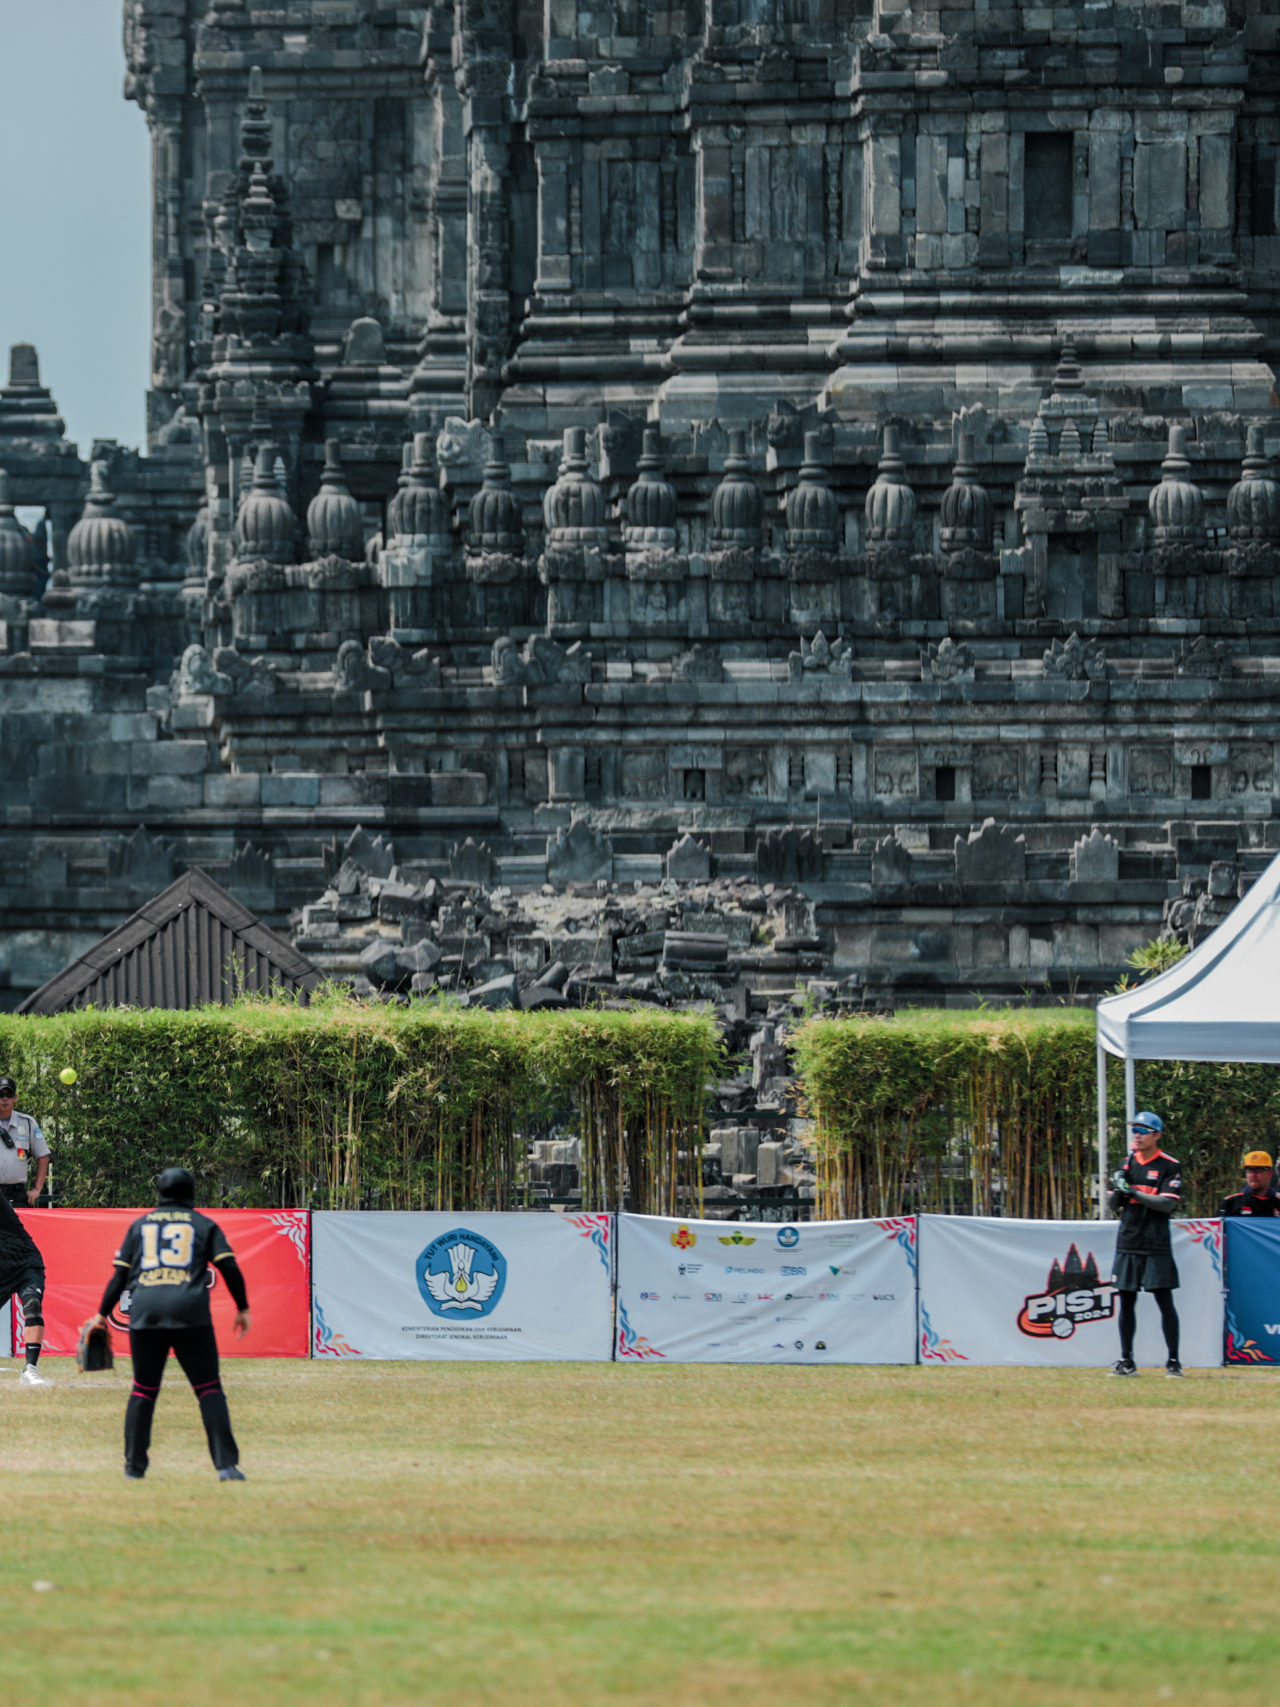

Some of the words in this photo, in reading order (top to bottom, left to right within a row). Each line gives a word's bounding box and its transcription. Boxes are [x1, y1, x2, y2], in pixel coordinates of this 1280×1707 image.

[141, 1223, 195, 1270] 13
[424, 1244, 438, 1260] TUT
[436, 1233, 458, 1247] WURI
[459, 1233, 499, 1261] HANDAYANI
[1028, 1286, 1119, 1320] PIST
[1074, 1308, 1110, 1321] 2024
